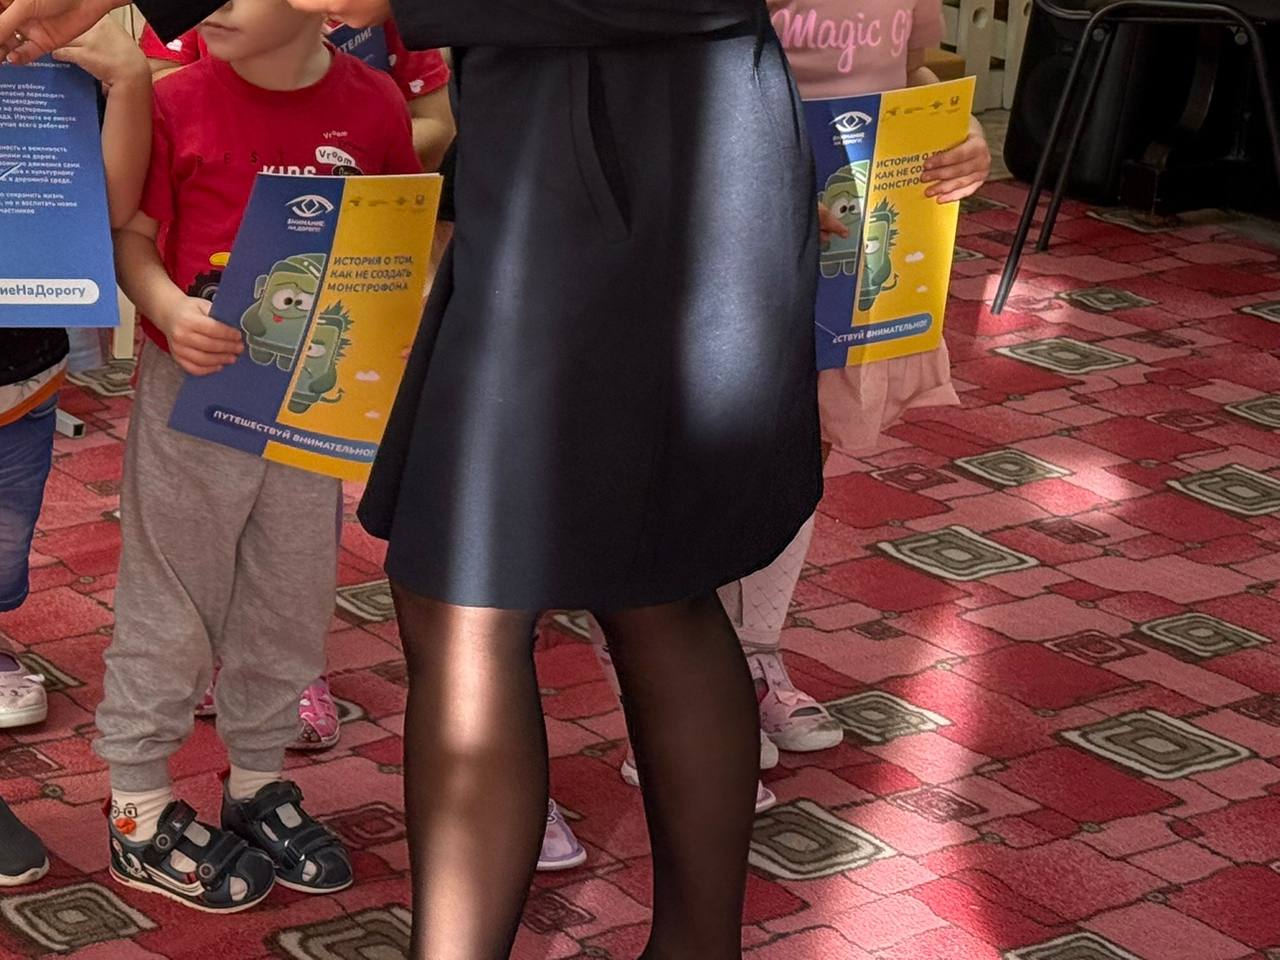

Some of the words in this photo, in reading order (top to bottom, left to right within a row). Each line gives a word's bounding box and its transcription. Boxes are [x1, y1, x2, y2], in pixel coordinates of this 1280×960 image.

[771, 8, 882, 73] Magic
[323, 130, 348, 139] Vroom
[319, 149, 353, 165] Vroom
[876, 154, 920, 169] ИСТОРИЯ
[875, 170, 895, 180] КАК
[896, 167, 909, 178] НЕ
[333, 256, 382, 266] ИСТОРИЯ
[383, 256, 391, 265] О
[330, 270, 353, 280] КАК
[355, 270, 369, 279] НЕ
[370, 270, 412, 280] СОЗДАТЬ
[327, 283, 409, 293] МОНСТРОФОНА
[867, 318, 928, 338] ВНИМАТЕЛЬНО!
[213, 409, 291, 441] ПУТЕШЕСТВУЙ
[292, 434, 377, 457] ВНИМАТЕЛЬНО!
